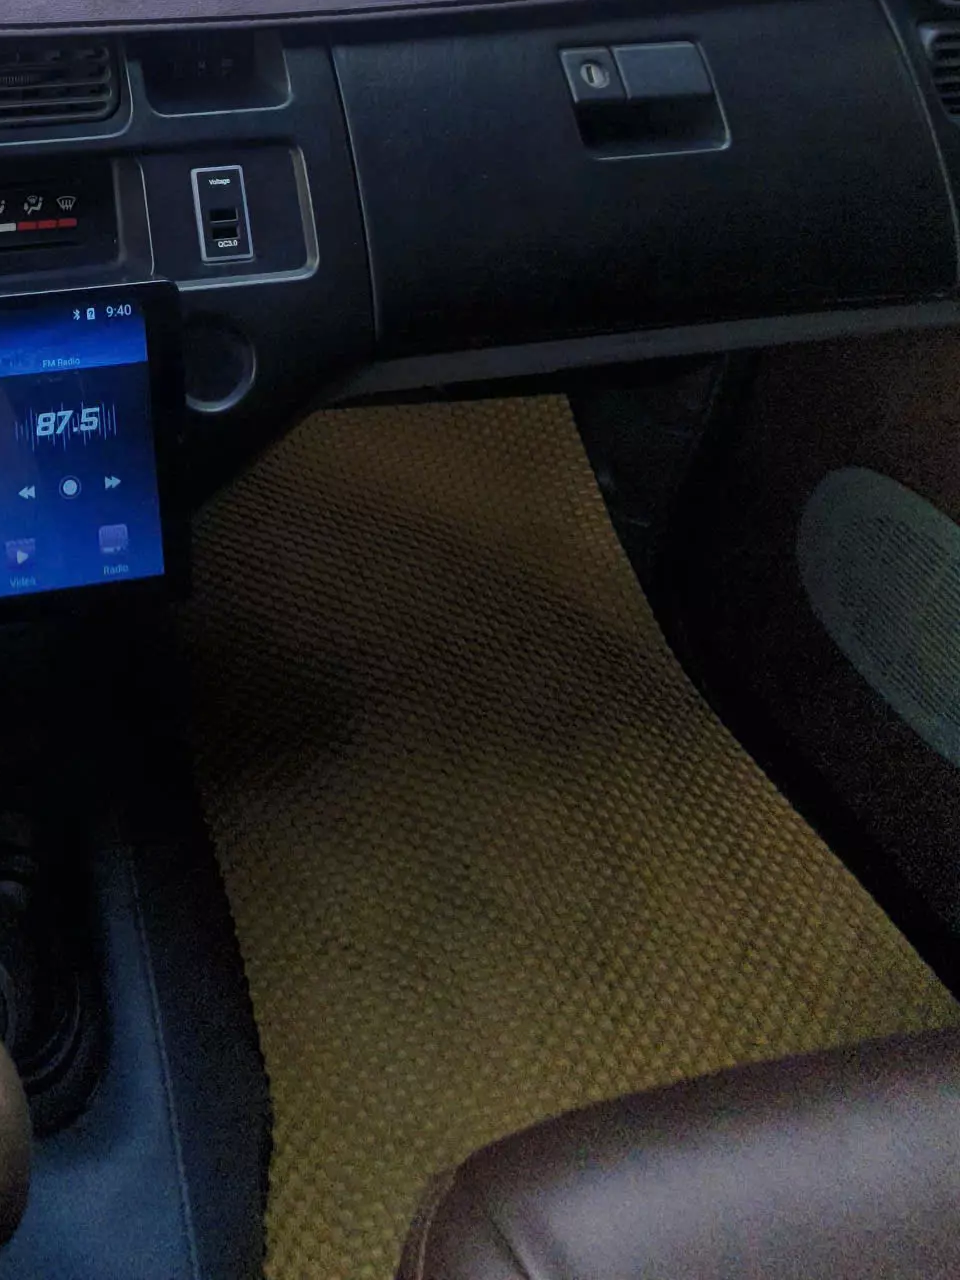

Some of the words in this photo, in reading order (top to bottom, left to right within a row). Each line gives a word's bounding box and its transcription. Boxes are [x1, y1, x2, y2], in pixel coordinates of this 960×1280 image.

[209, 178, 231, 186] Voltage
[217, 239, 238, 248] QC3.0
[106, 304, 132, 318] 9:40
[42, 359, 56, 368] FM
[58, 357, 81, 367] Radio
[36, 407, 100, 436] 87.5
[103, 565, 129, 575] Radio
[9, 576, 37, 588] Video
